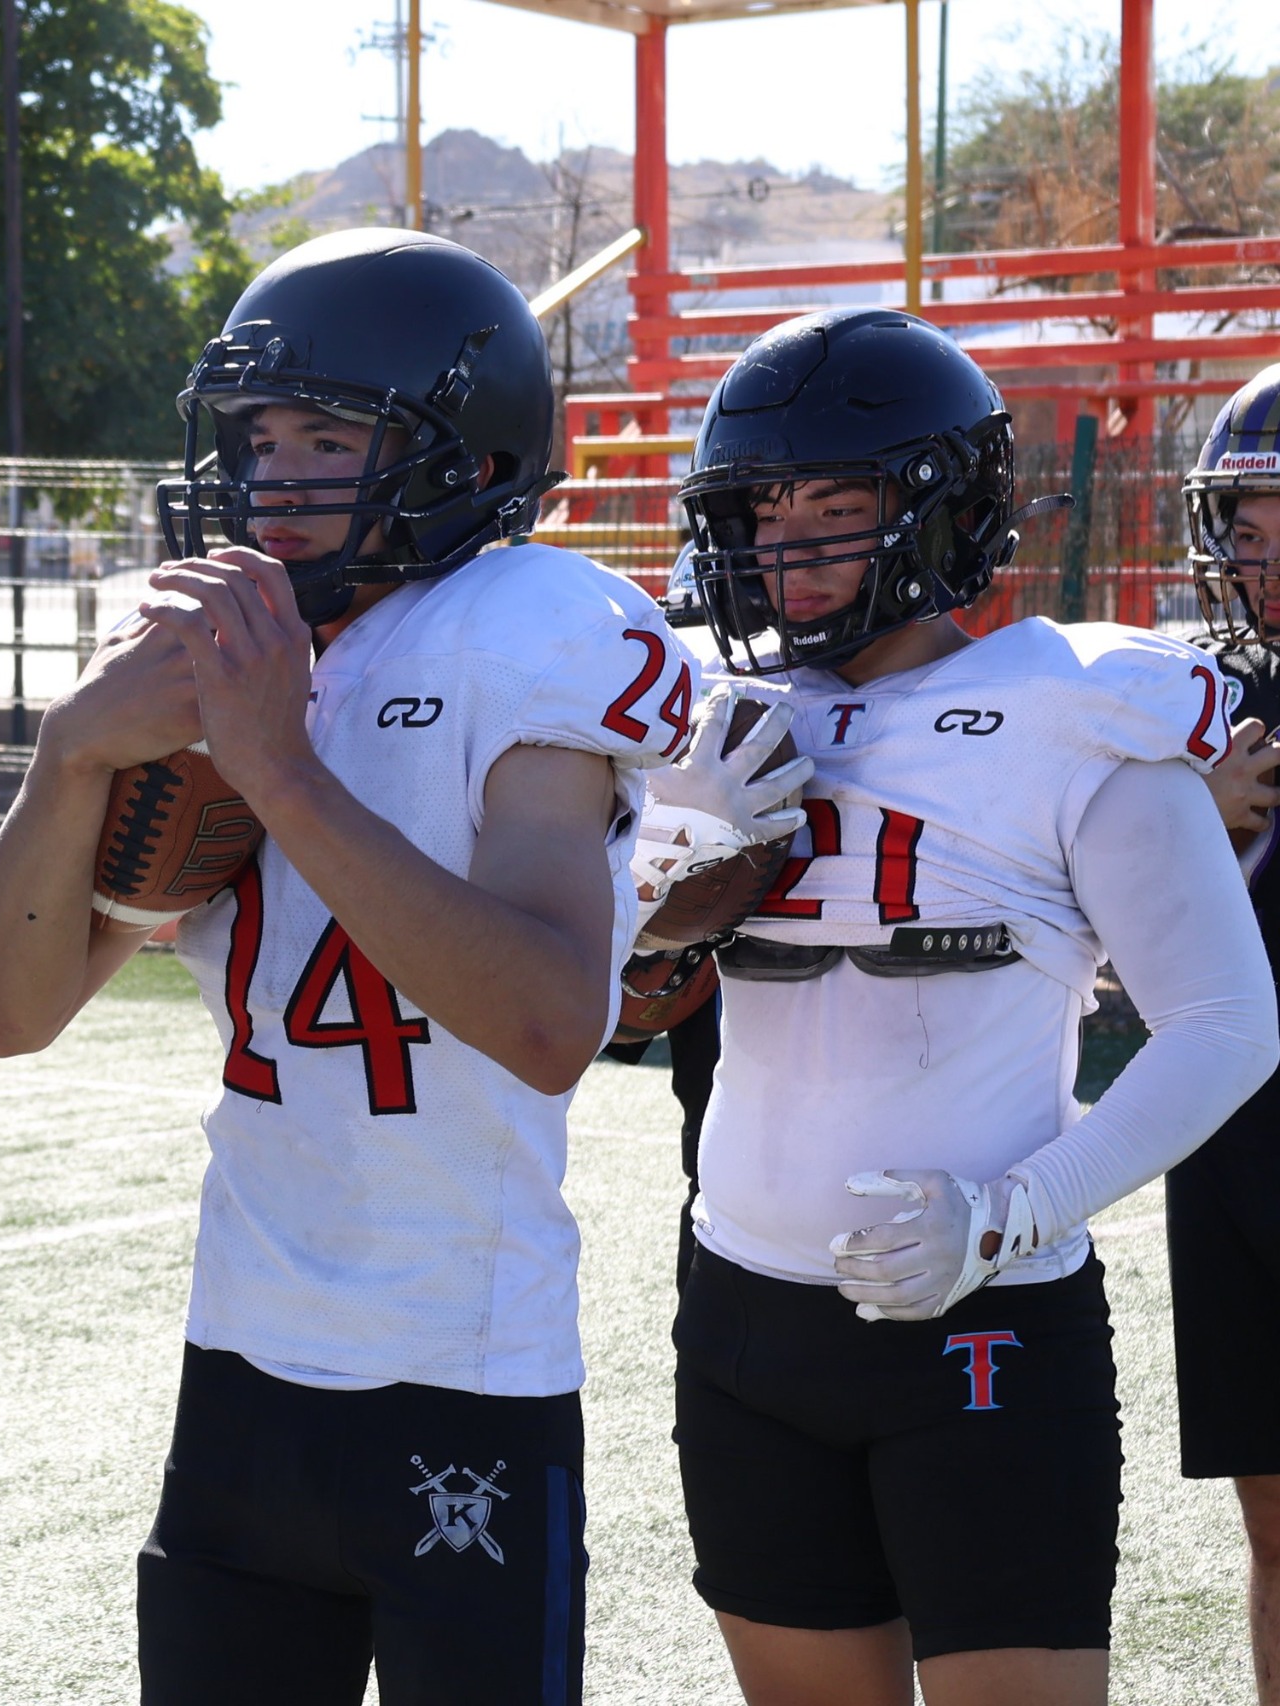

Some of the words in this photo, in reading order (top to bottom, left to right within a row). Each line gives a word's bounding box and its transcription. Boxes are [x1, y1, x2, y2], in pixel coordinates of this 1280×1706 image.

[1222, 456, 1276, 470] Riddell
[792, 631, 827, 646] Riddell
[601, 628, 692, 757] 24
[827, 703, 866, 746] T
[942, 1330, 1024, 1410] T
[443, 1503, 478, 1531] K
